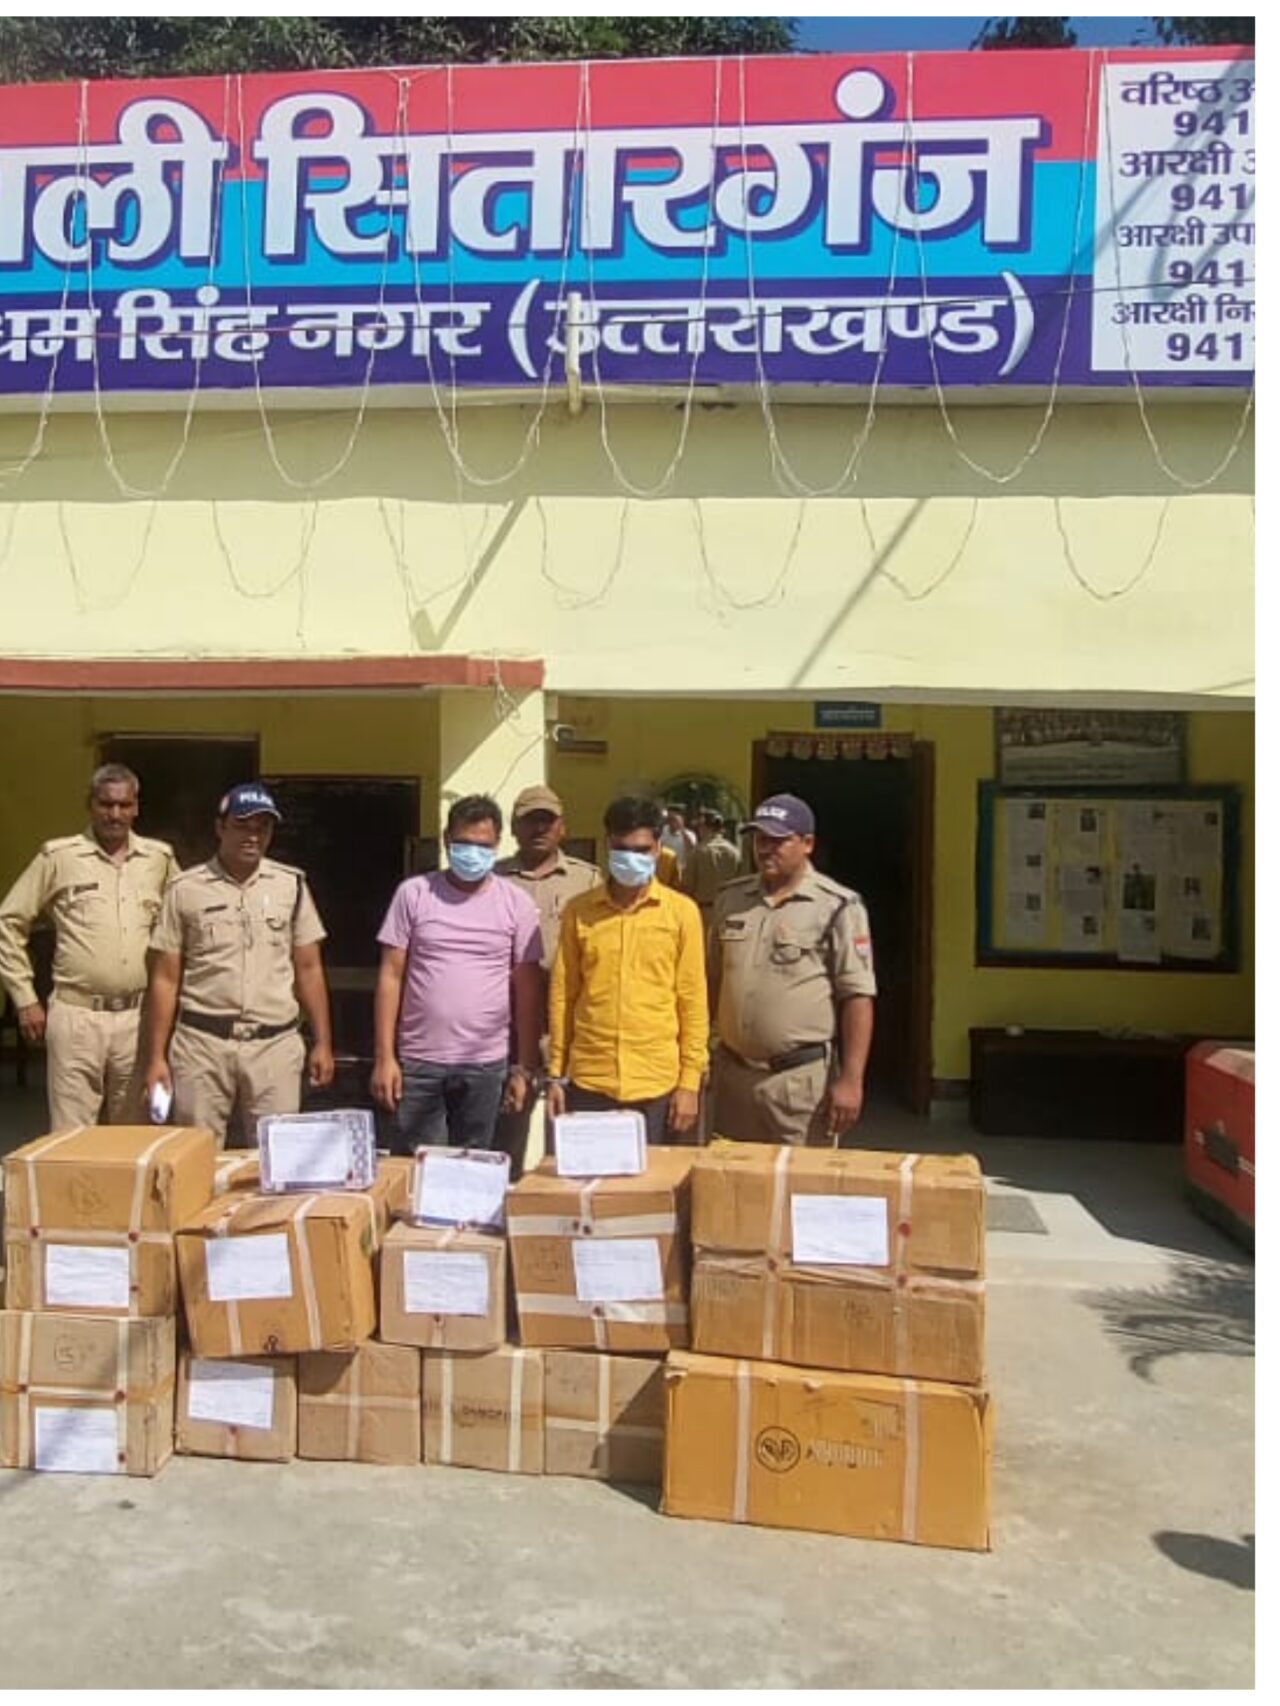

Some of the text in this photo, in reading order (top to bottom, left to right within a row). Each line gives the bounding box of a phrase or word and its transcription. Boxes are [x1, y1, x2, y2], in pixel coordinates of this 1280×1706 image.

[1120, 71, 1225, 105] वरिष्ठ
[1173, 109, 1250, 136] 941
[255, 70, 1041, 258] सितारगंज
[1119, 141, 1235, 177] आरक्षी
[1170, 182, 1248, 213] 941
[1118, 216, 1206, 247] आरक्षी
[1168, 258, 1255, 289] 941
[113, 285, 279, 361] सिंह
[286, 301, 491, 357] नगर
[1111, 292, 1255, 324] आरक्षी नि
[1166, 332, 1255, 362] 941
